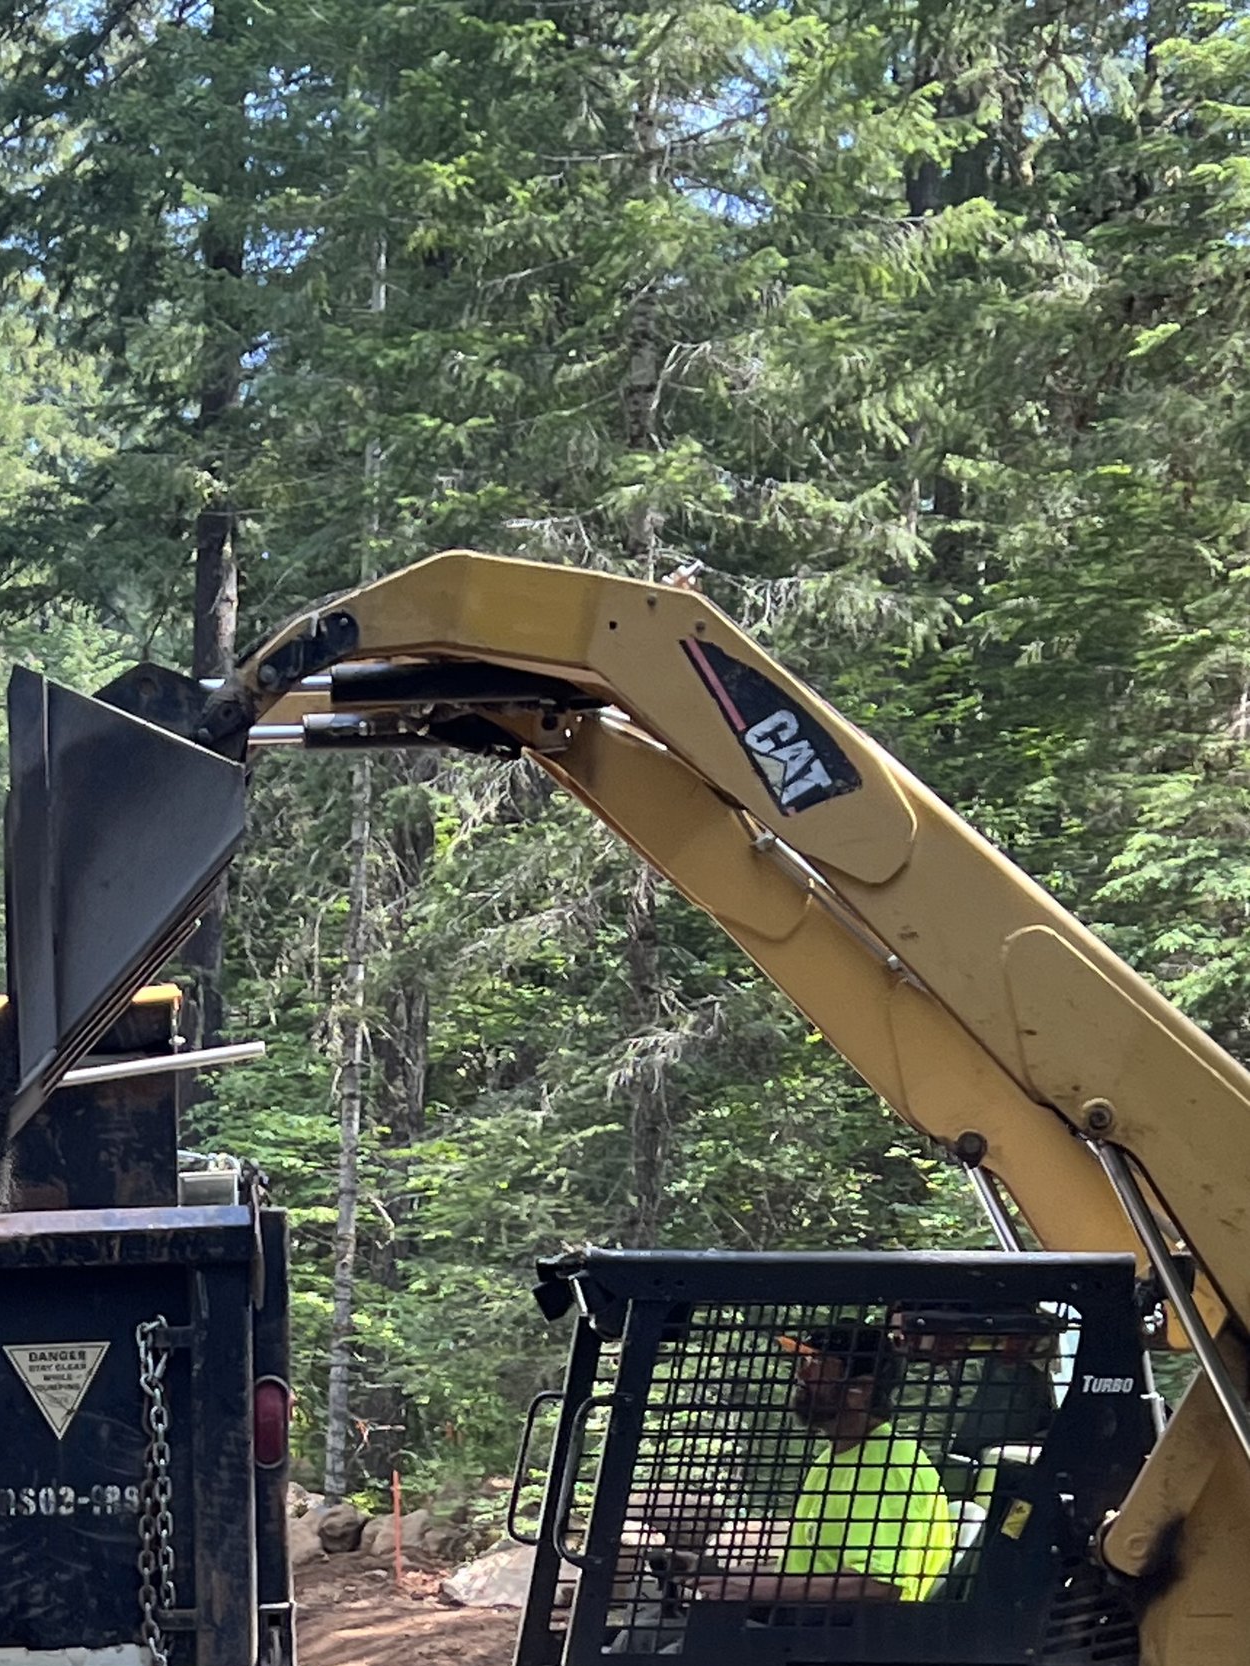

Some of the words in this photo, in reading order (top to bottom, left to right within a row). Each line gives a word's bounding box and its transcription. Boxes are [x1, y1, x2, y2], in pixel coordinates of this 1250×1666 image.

[745, 709, 832, 806] CAT
[29, 1351, 86, 1362] DANGER
[29, 1364, 53, 1373] STAY
[55, 1363, 86, 1371] CLEAR
[1082, 1375, 1134, 1393] TURBO
